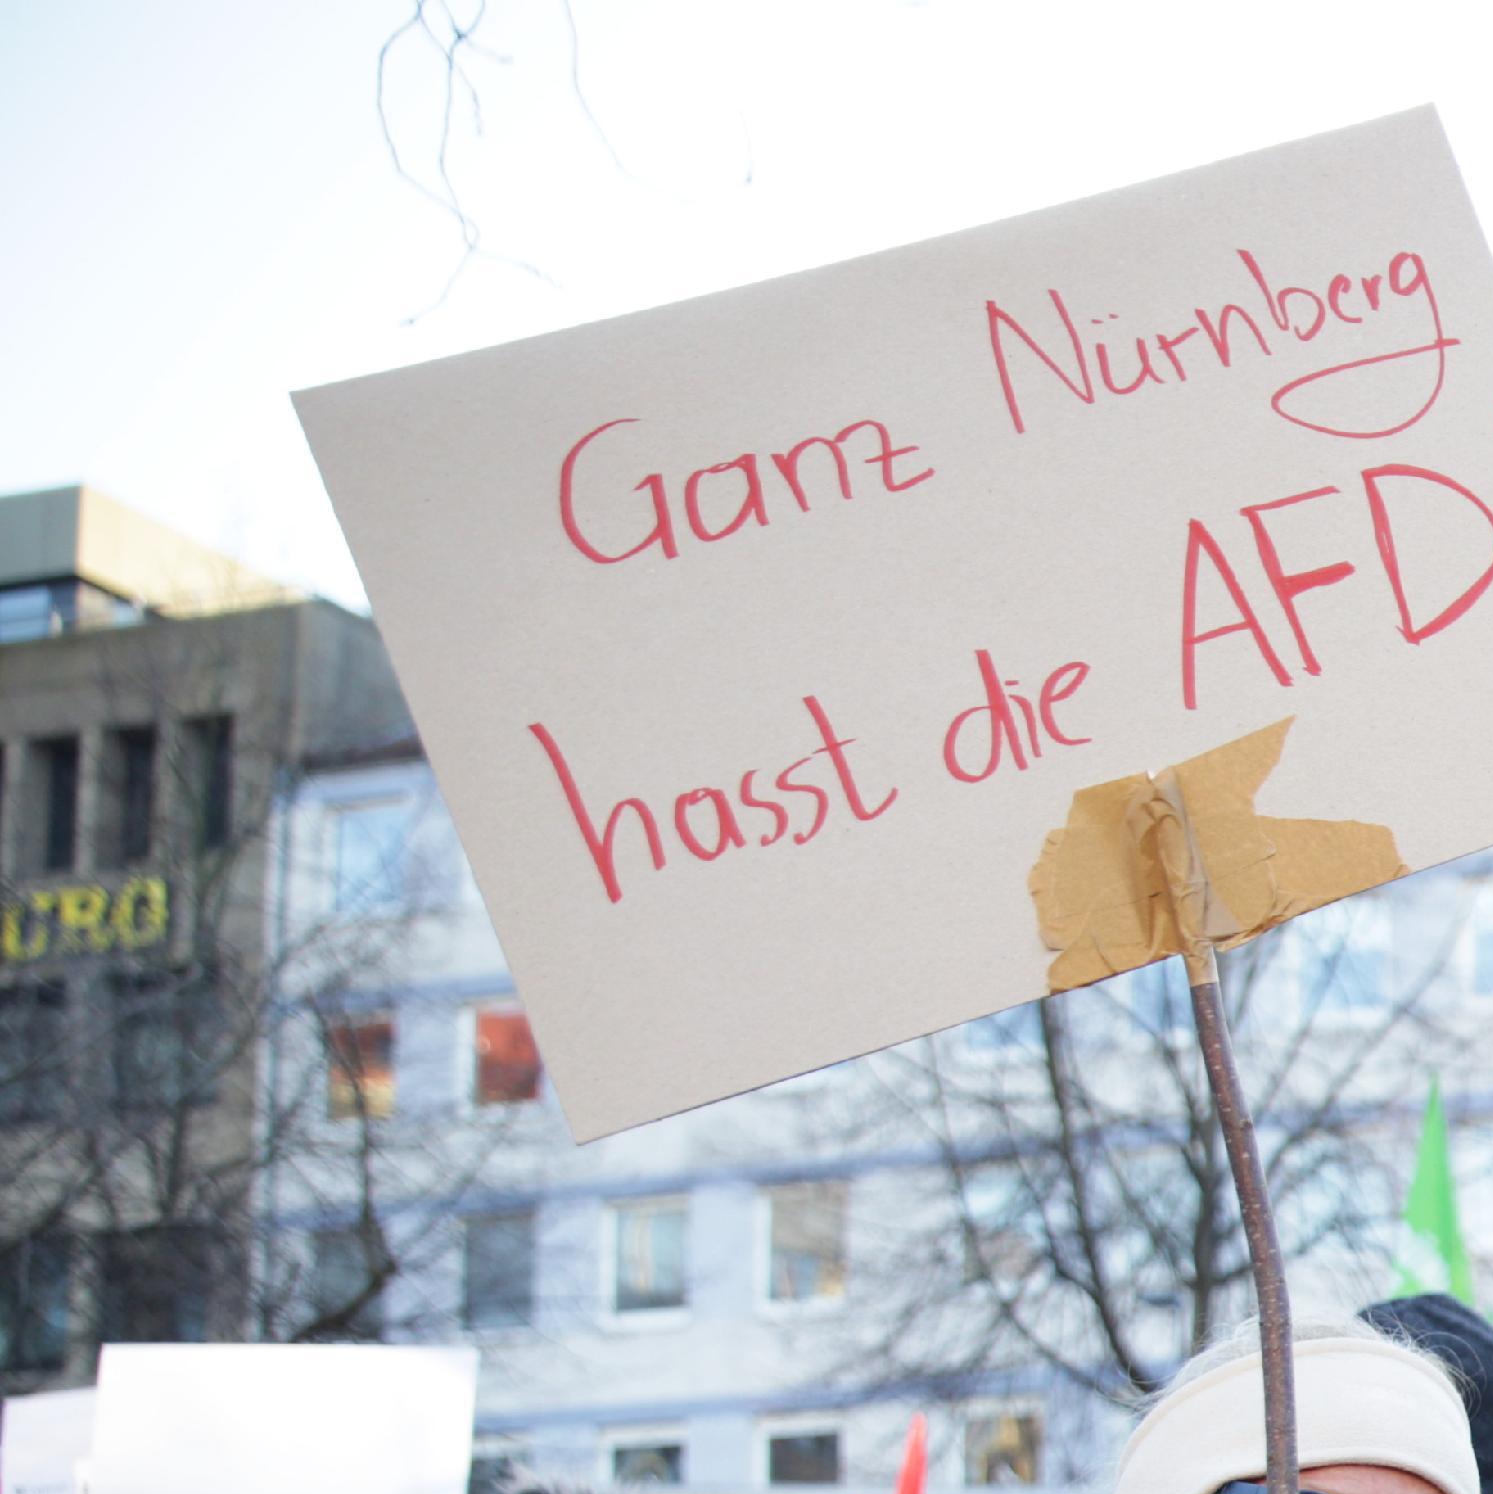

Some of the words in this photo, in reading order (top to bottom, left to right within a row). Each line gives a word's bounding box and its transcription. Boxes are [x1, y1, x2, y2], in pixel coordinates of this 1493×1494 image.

[558, 418, 936, 565] Ganz
[984, 248, 1463, 440] Nürnberg
[527, 694, 898, 904] hasst
[943, 649, 1092, 784] die
